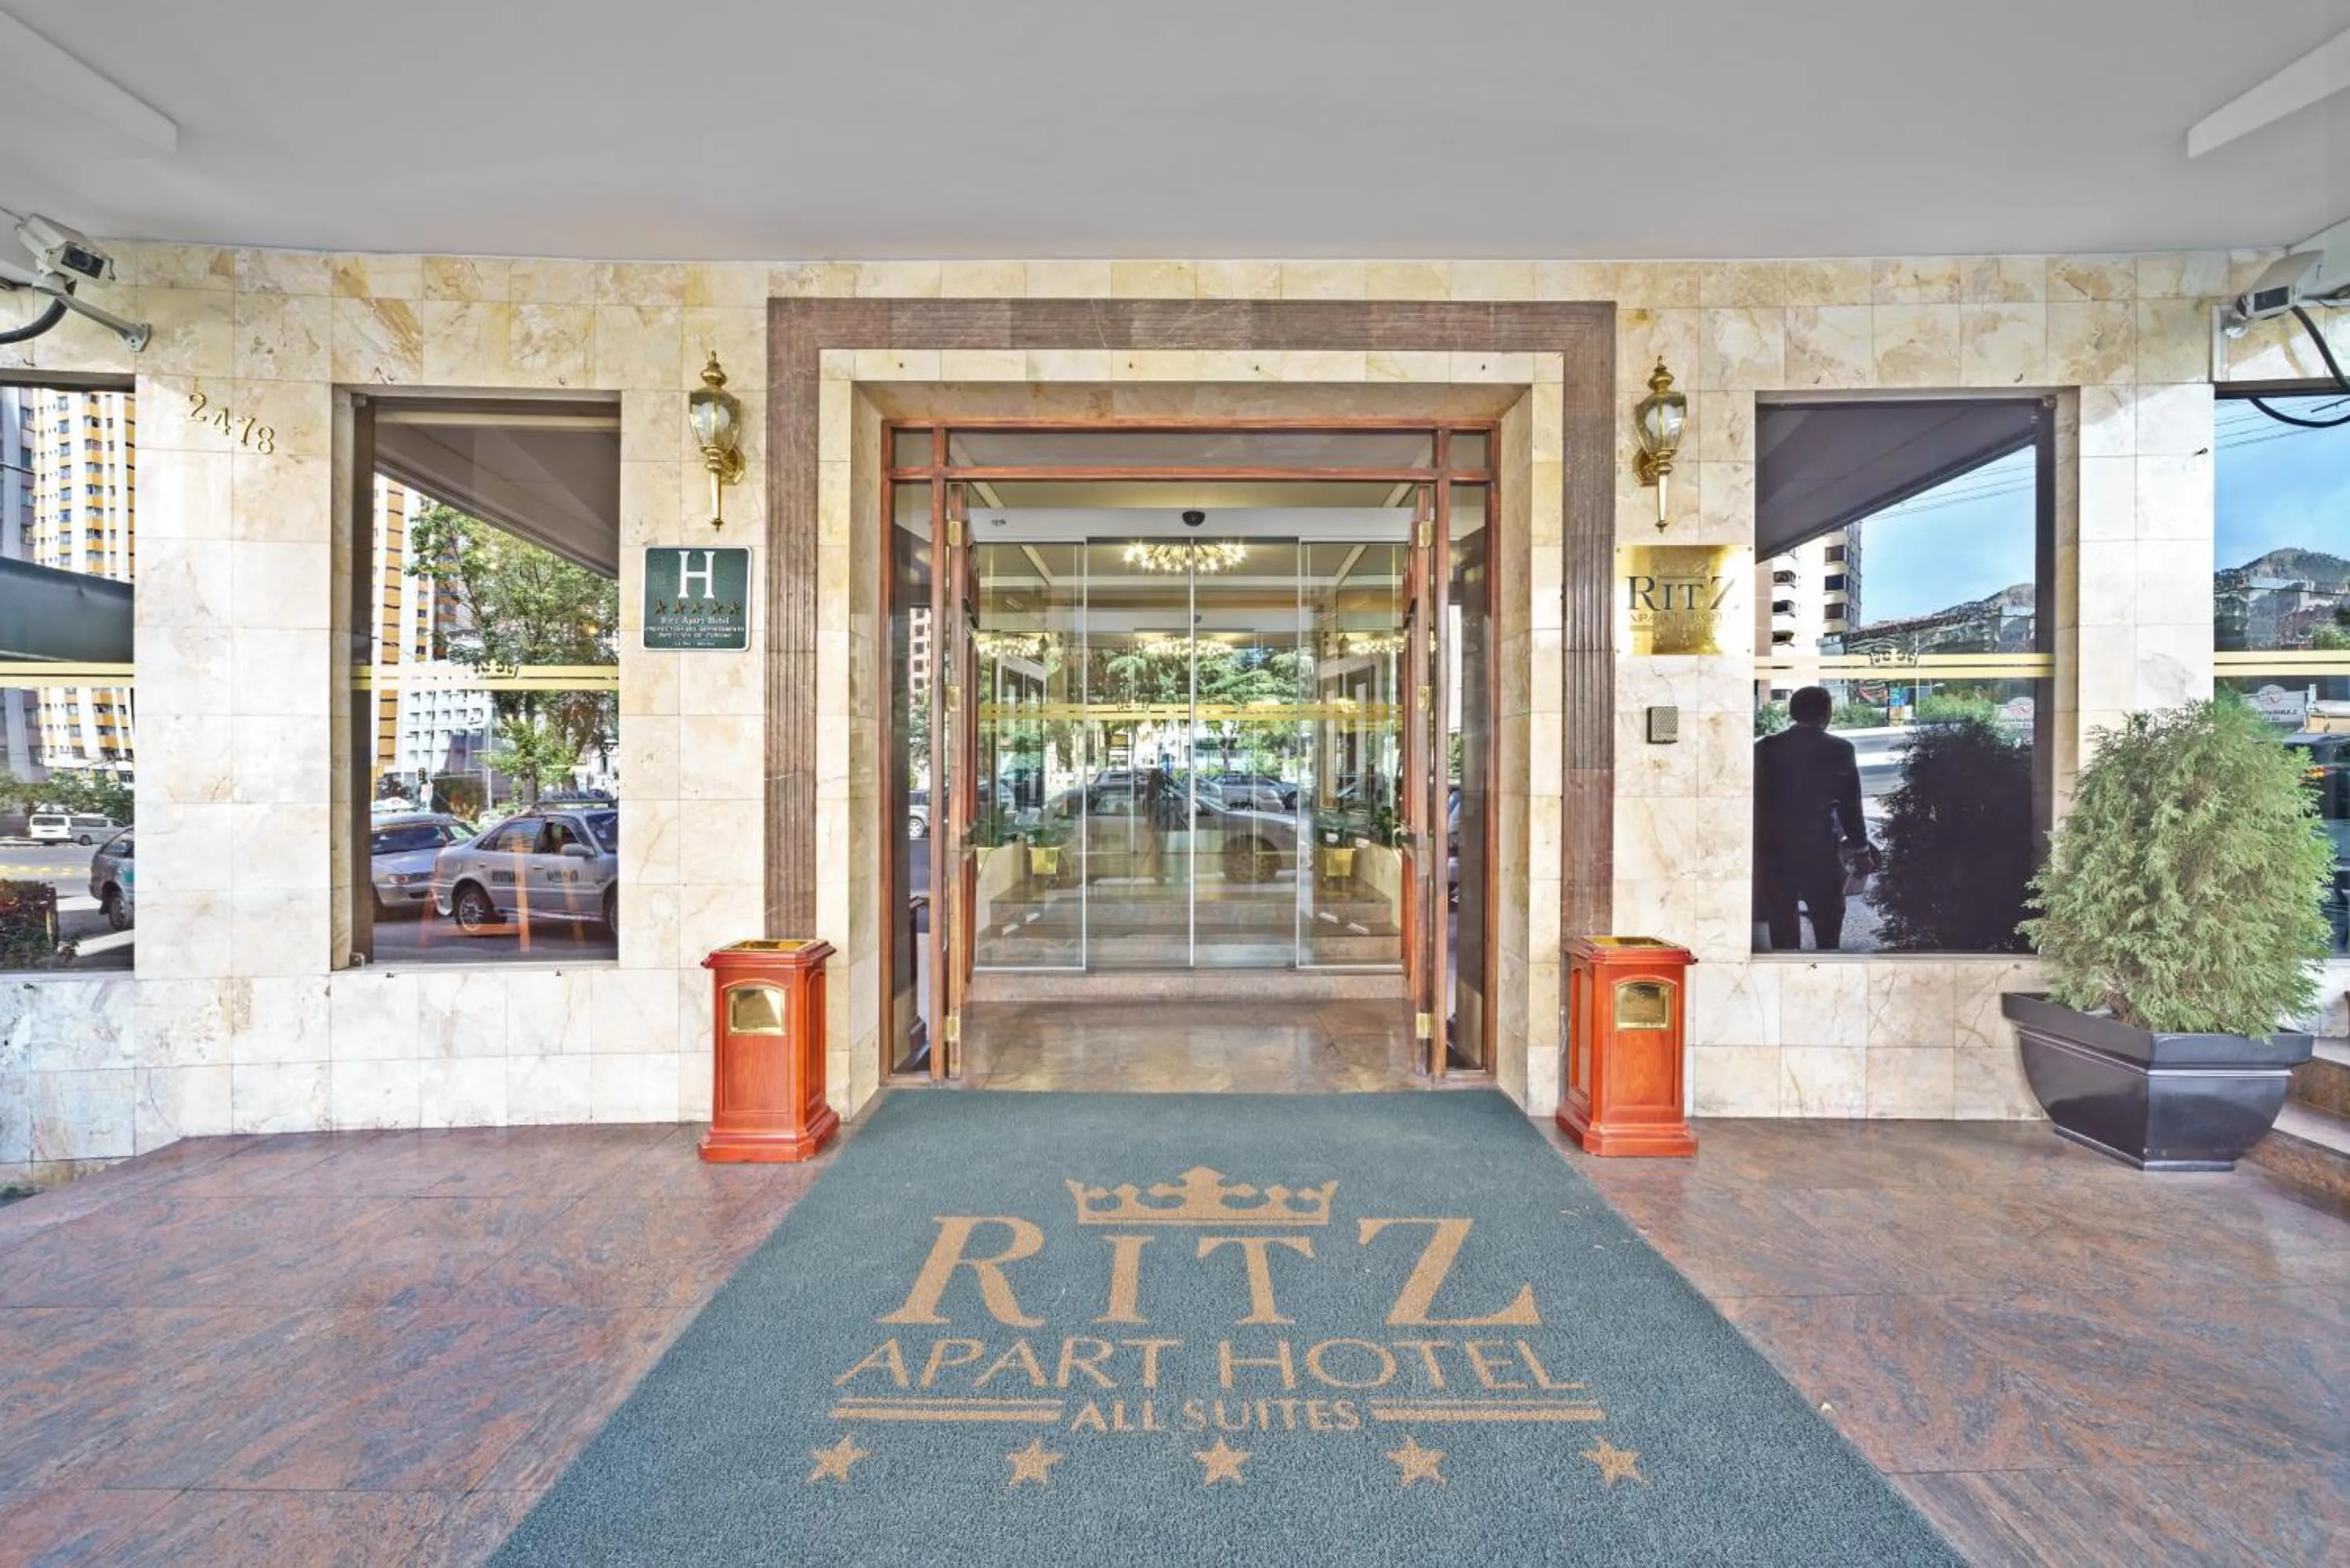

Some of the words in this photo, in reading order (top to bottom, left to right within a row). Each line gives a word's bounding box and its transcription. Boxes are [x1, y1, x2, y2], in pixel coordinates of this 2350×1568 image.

[188, 391, 275, 454] 2478
[678, 551, 715, 599] H
[1625, 576, 1740, 610] RITZ
[877, 1215, 1543, 1328] RITZ
[833, 1337, 1183, 1389] APART
[1218, 1338, 1586, 1391] HOTEL
[1071, 1399, 1162, 1433] ALL
[1183, 1398, 1362, 1433] SUITES
